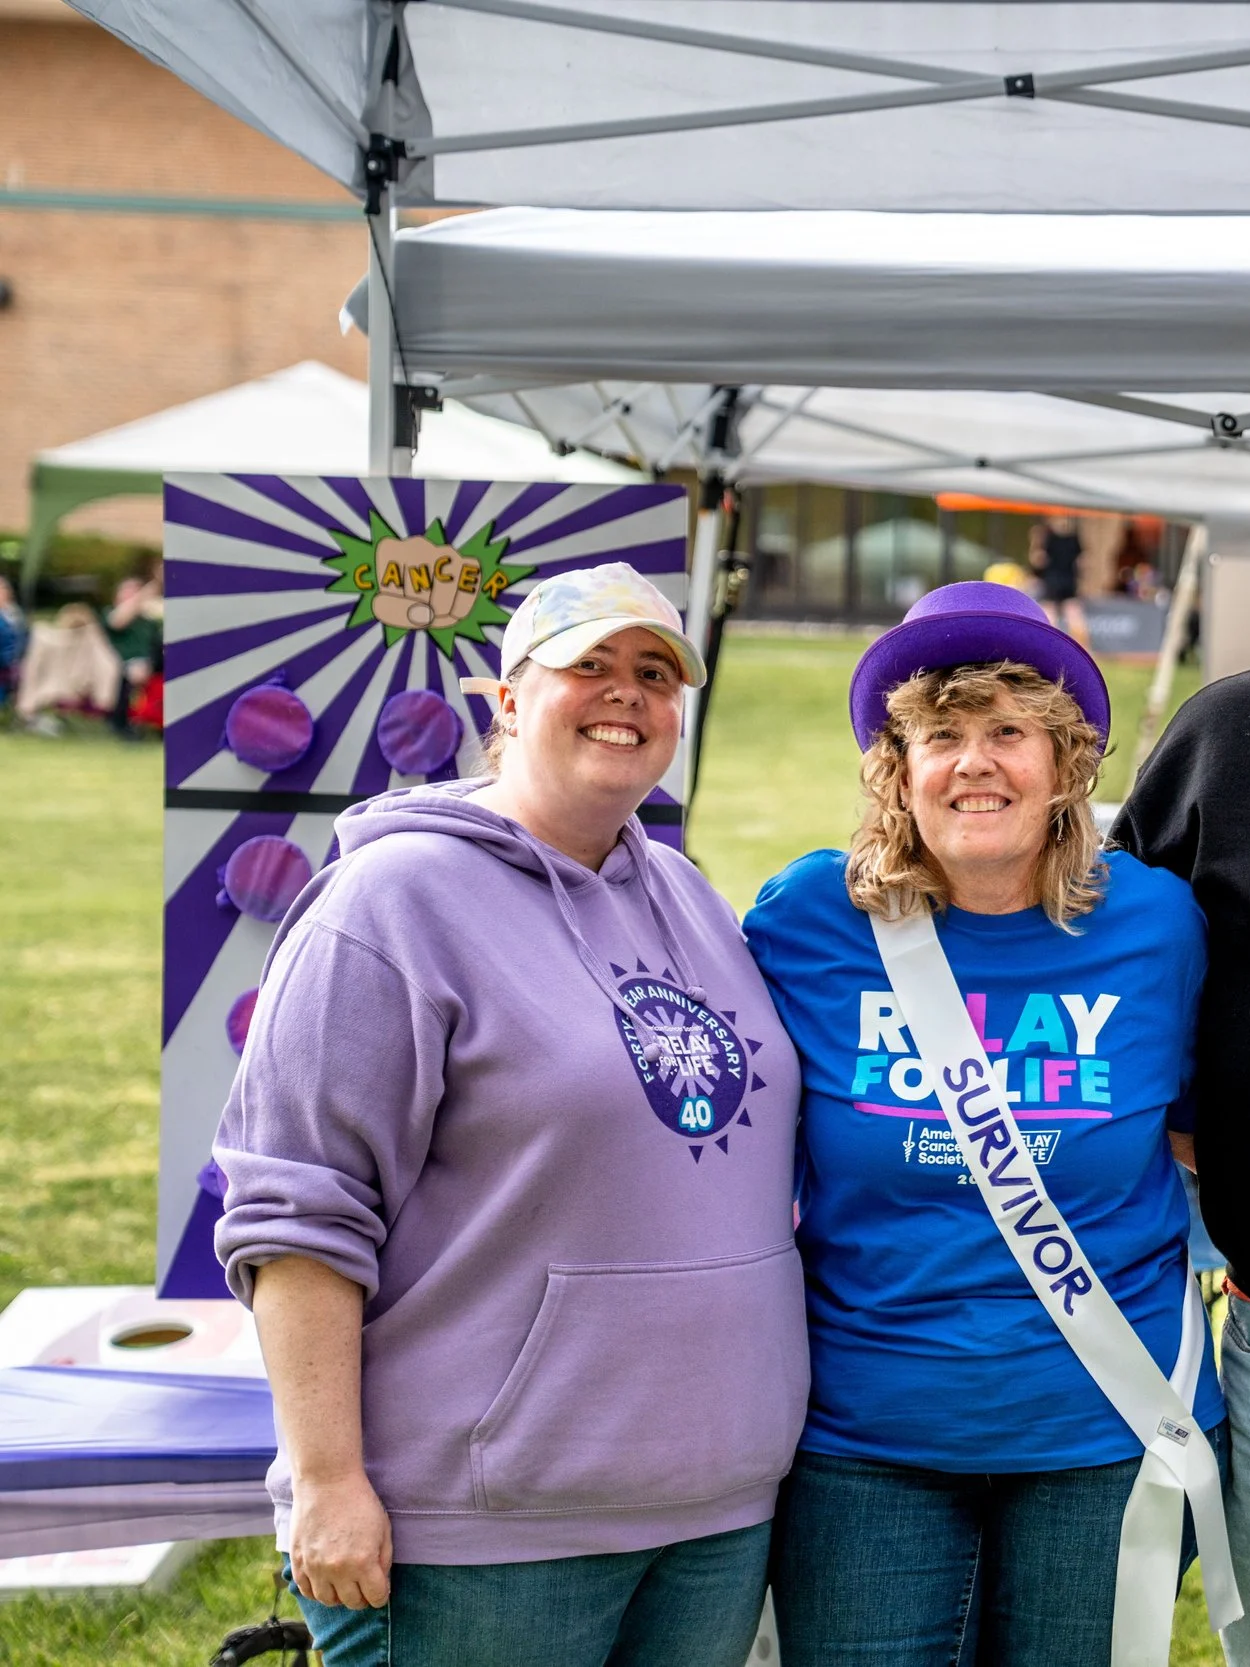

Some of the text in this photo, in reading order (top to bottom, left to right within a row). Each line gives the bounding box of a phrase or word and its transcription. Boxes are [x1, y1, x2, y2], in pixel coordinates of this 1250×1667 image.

[353, 556, 509, 600] CANCER
[647, 985, 742, 1080] ANNIVERSARY
[657, 1034, 712, 1055] RELAY
[858, 991, 1121, 1055] RLAY
[676, 1055, 715, 1077] LIFE
[851, 1054, 1112, 1104] FO LIFE
[680, 1098, 713, 1129] 40
[918, 1140, 962, 1152] Cance
[943, 1058, 1092, 1317] SURVIVOR
